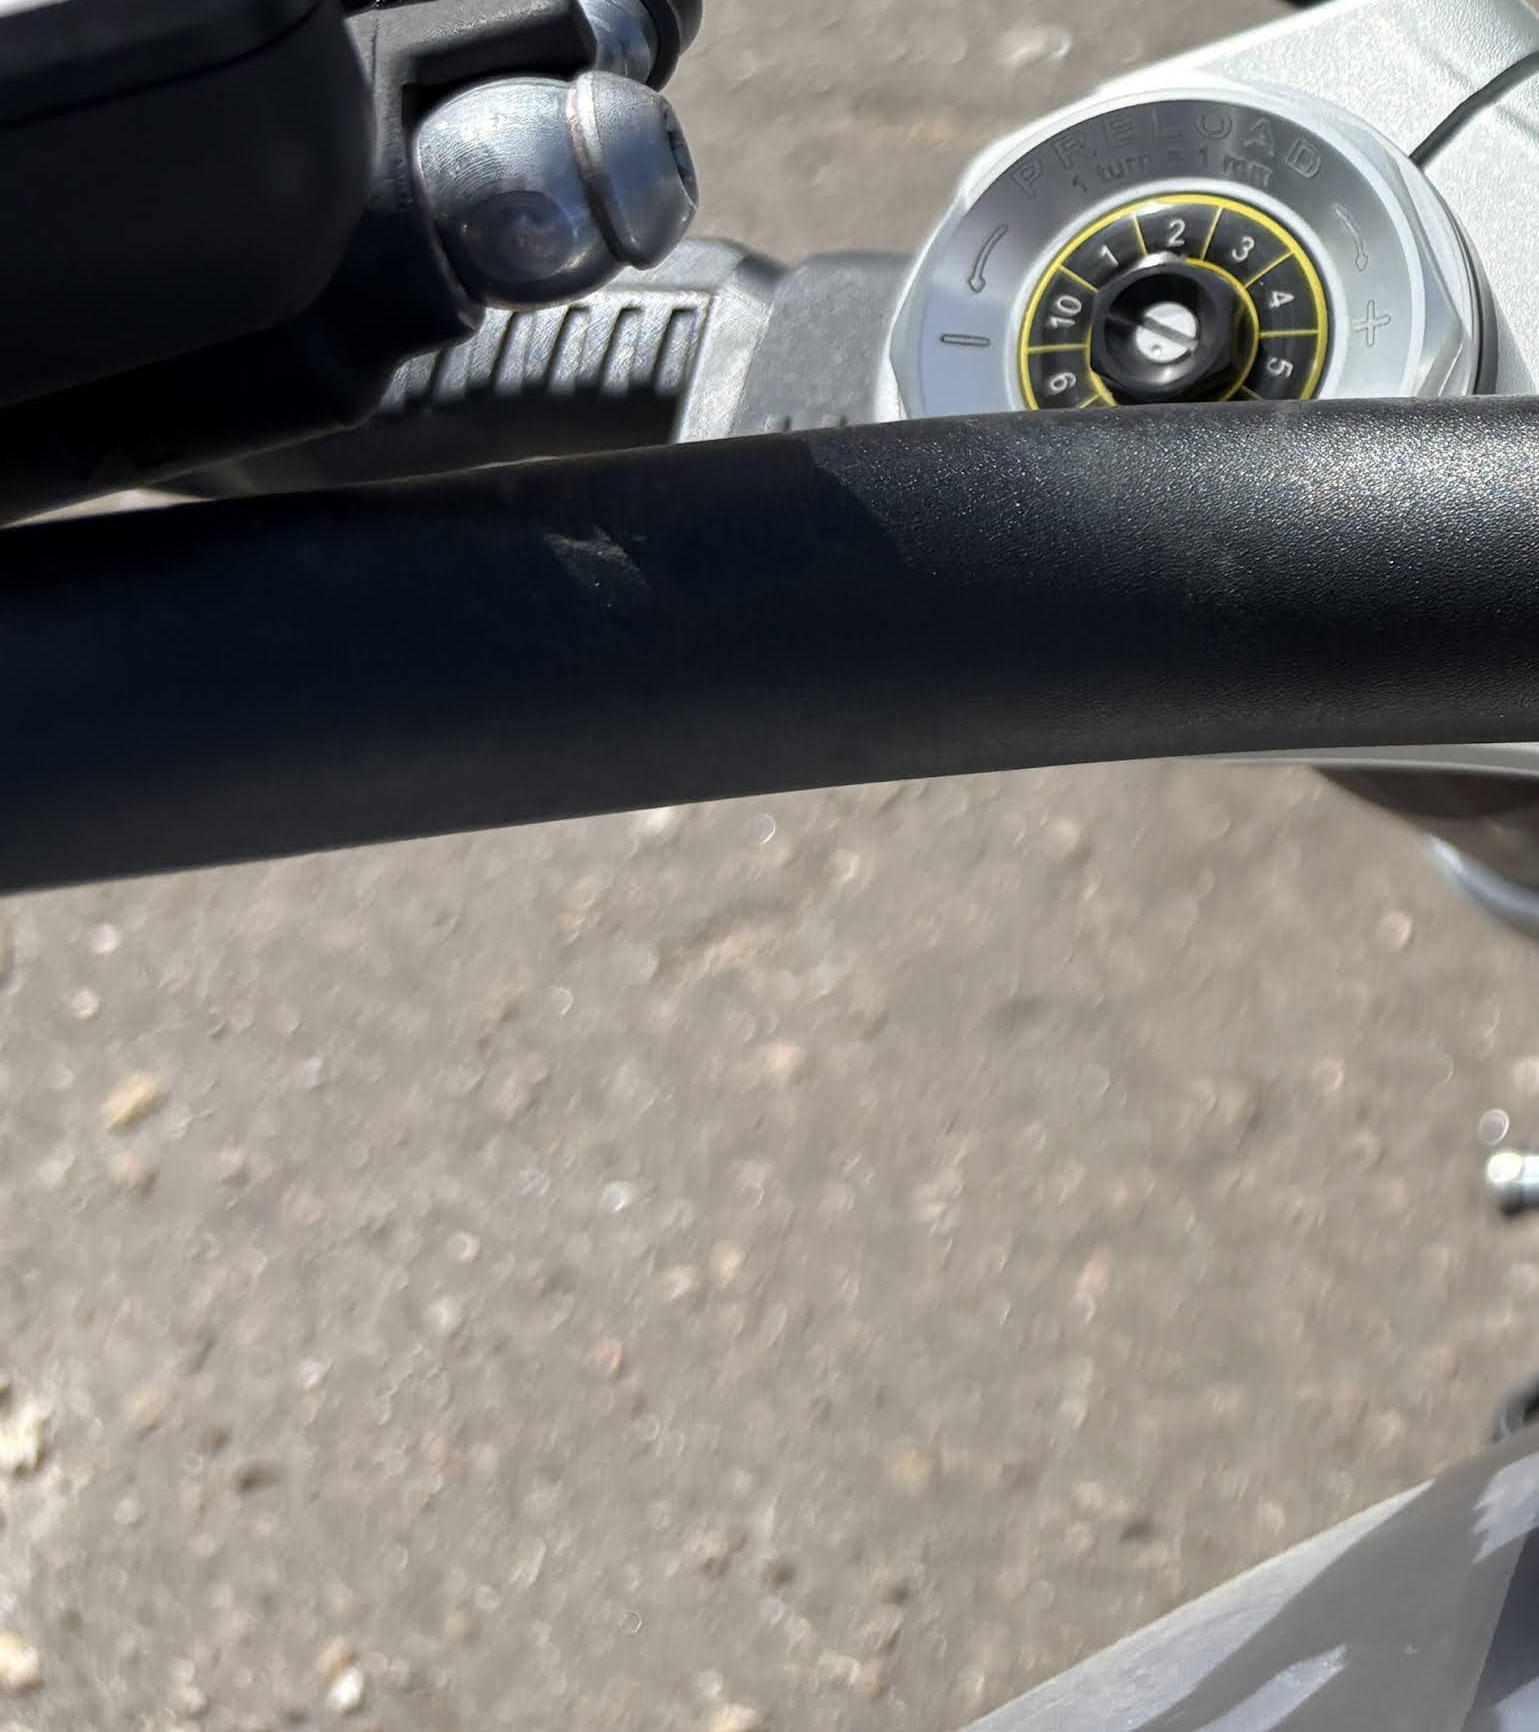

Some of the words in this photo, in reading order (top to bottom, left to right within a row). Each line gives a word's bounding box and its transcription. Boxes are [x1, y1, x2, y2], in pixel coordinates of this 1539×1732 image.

[1012, 104, 1322, 198] PRELOAD
[1168, 219, 1186, 248] 2
[1099, 245, 1120, 268] 1
[1232, 236, 1255, 262] 3
[1050, 293, 1082, 329] 10
[1269, 290, 1295, 309] 4
[1266, 357, 1293, 378] 5
